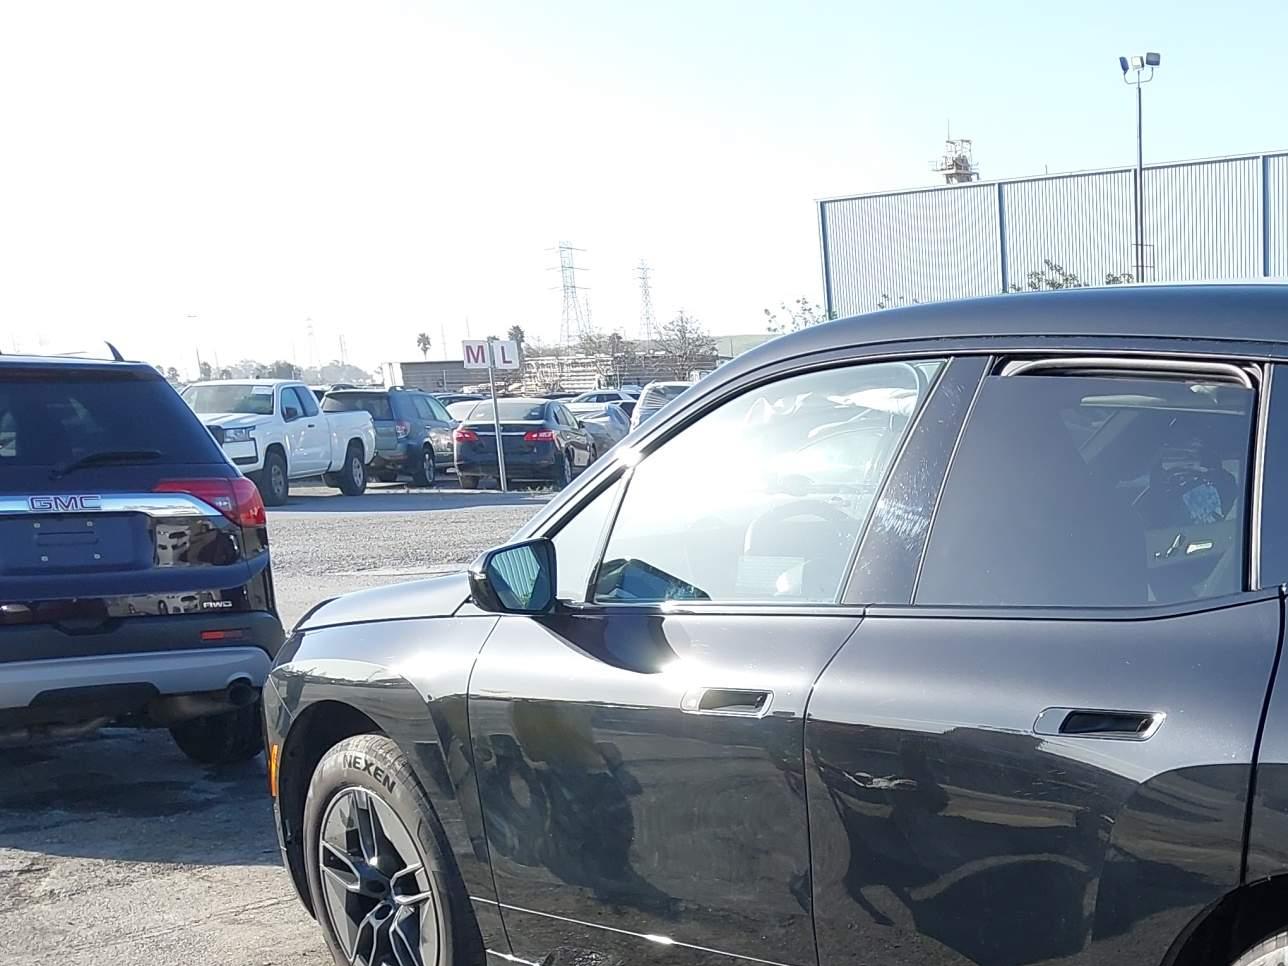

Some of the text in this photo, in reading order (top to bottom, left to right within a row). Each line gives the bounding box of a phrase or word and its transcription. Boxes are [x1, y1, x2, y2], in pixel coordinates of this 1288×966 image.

[465, 345, 486, 364] M
[500, 345, 513, 364] L
[29, 495, 102, 511] GMC
[203, 600, 233, 609] AWD
[342, 754, 397, 794] NEXEN
